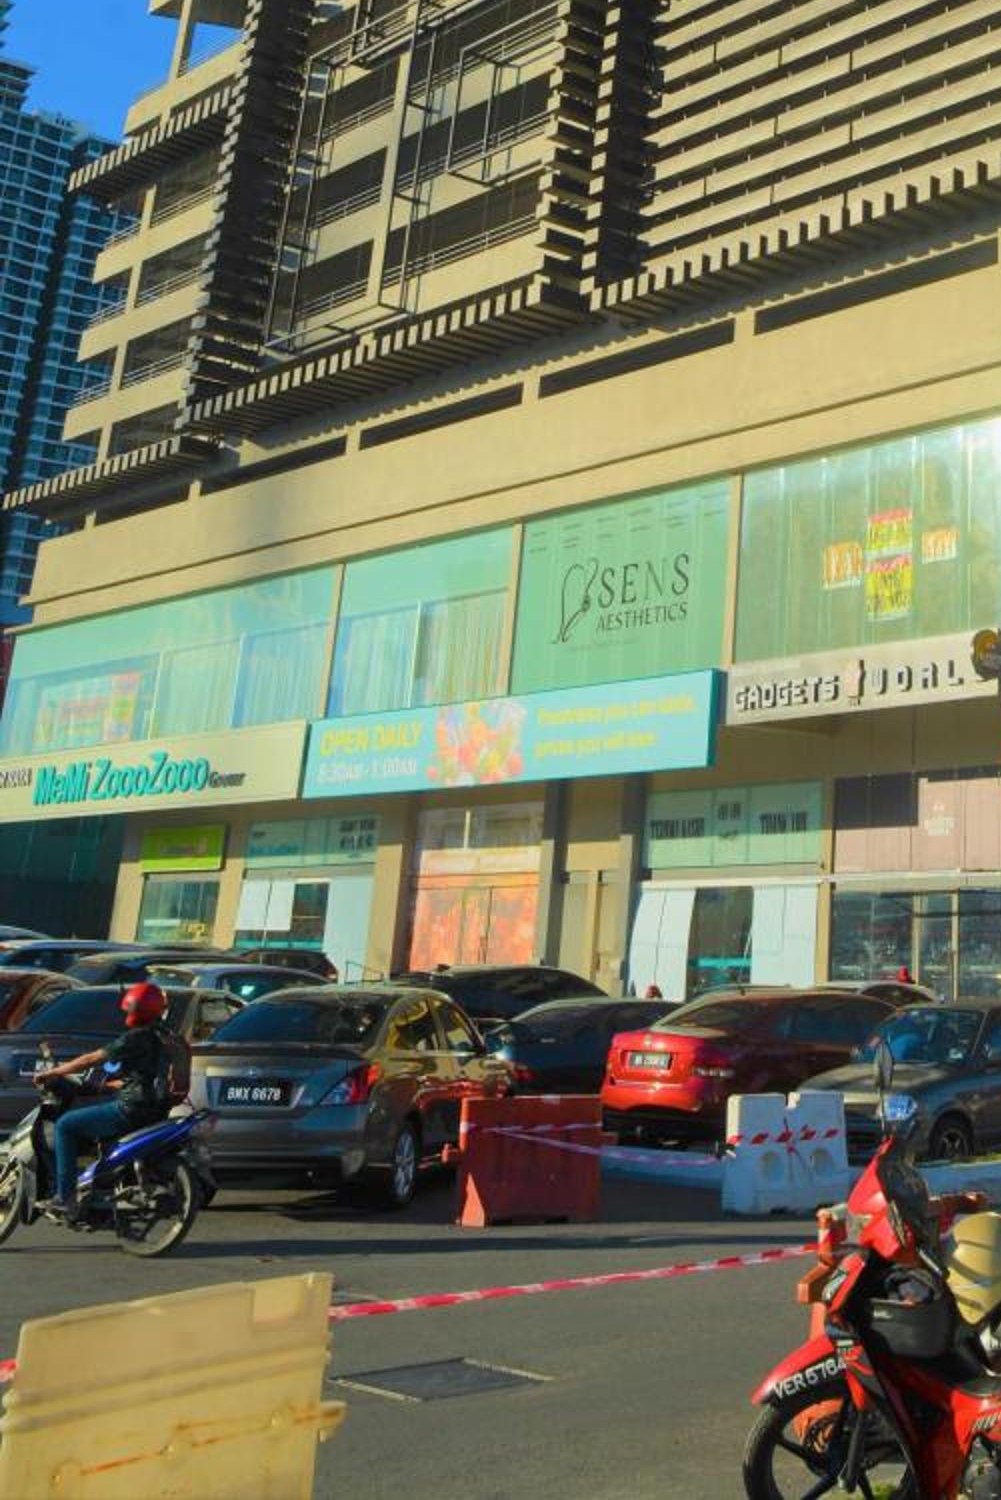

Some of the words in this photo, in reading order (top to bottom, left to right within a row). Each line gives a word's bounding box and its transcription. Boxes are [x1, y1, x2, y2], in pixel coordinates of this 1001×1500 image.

[597, 553, 690, 609] SENS
[596, 601, 689, 632] AESTHETICS
[736, 675, 840, 713] GADGETS
